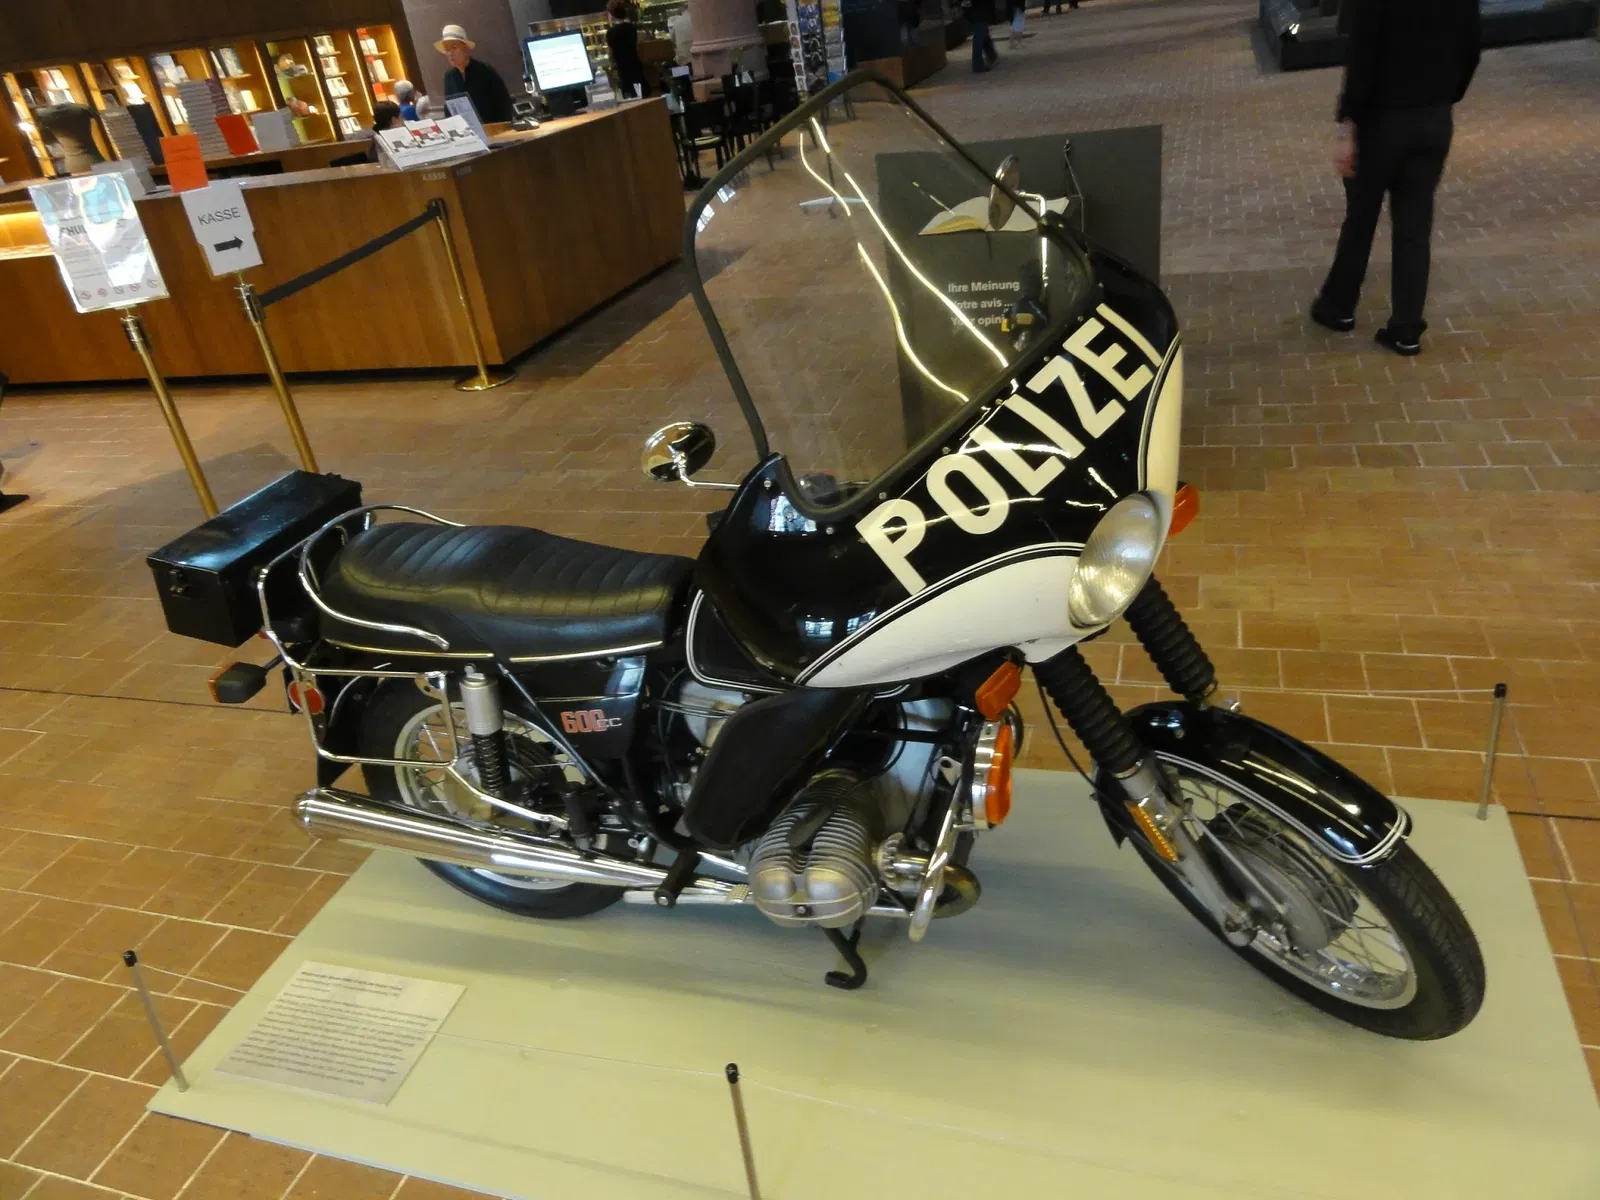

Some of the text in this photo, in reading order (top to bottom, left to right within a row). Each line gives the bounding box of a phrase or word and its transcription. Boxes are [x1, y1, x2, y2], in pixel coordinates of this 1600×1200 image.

[198, 207, 241, 225] KASSE
[948, 280, 1020, 293] Ihre Meinung
[950, 299, 977, 309] otre
[980, 297, 1002, 308] avis
[855, 303, 1163, 596] POLIZEI
